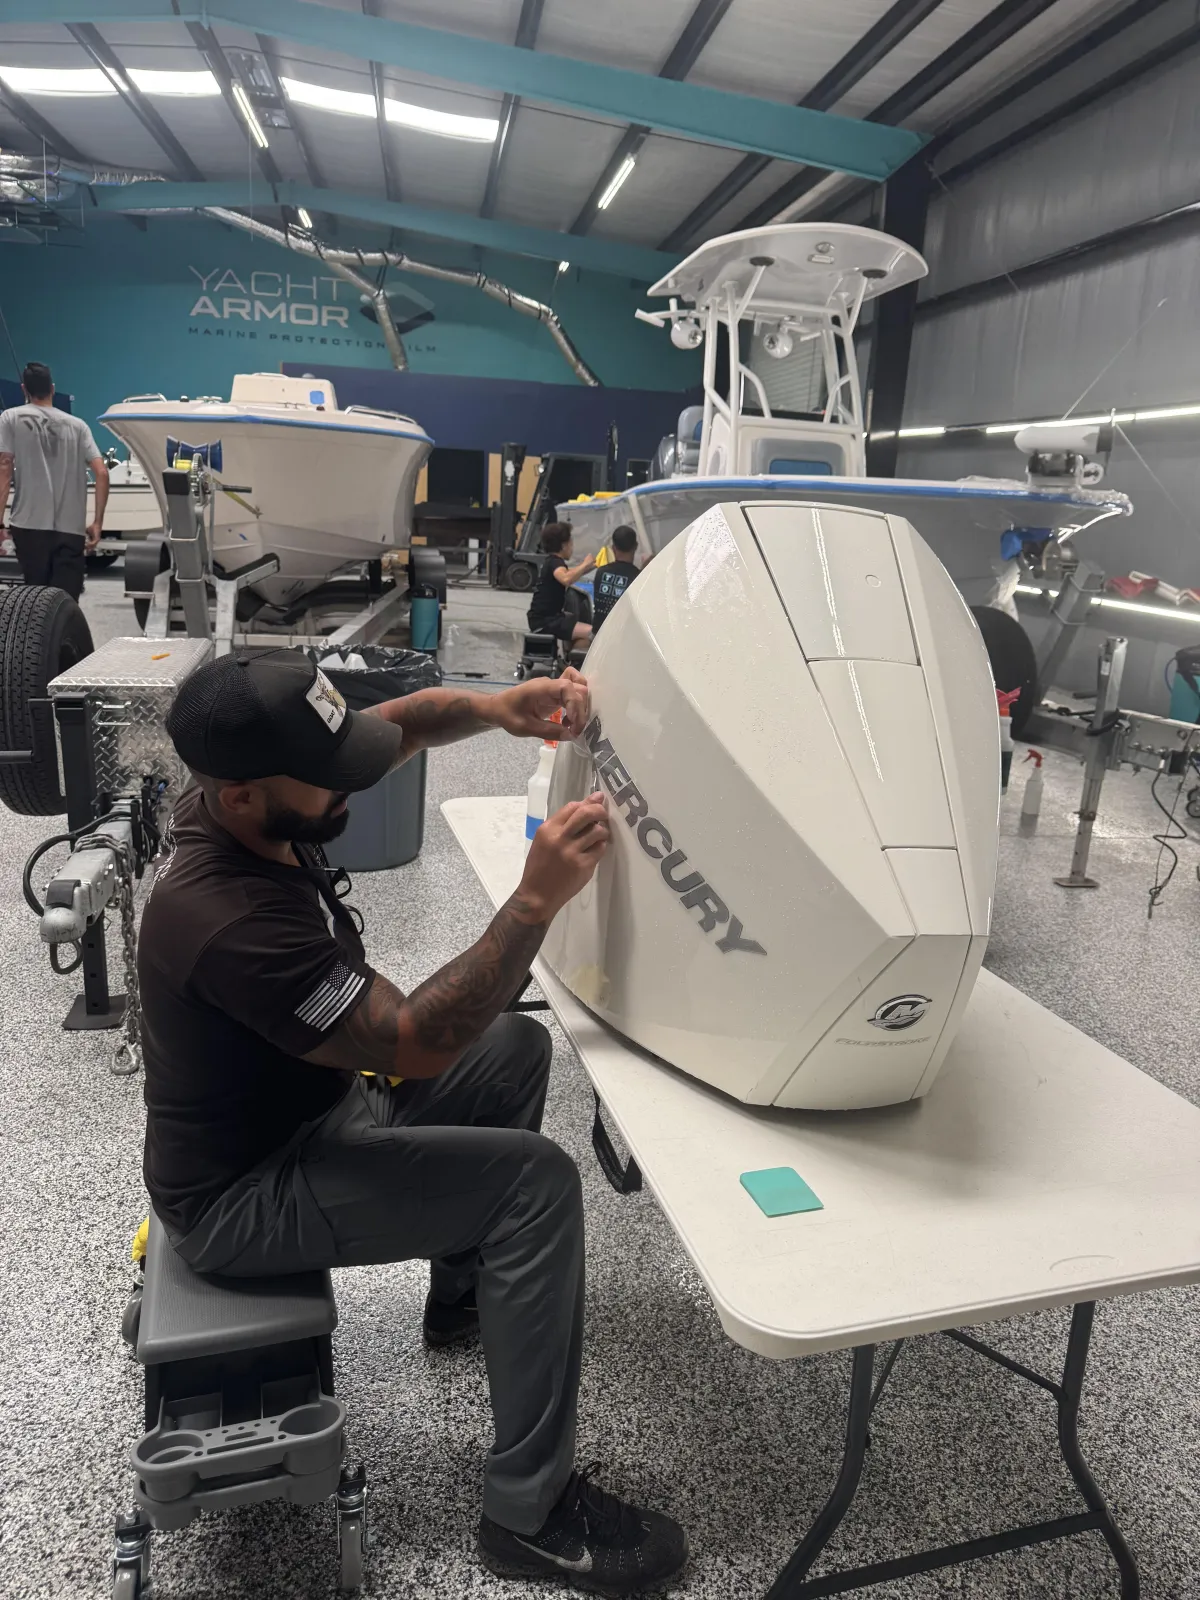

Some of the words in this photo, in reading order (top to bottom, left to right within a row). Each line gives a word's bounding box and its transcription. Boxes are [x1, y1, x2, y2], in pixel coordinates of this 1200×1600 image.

[189, 265, 349, 300] YACHT
[189, 296, 349, 328] ARMOR
[188, 327, 257, 339] MARINE
[269, 333, 386, 349] PROTECTION
[407, 344, 436, 352] ILM
[584, 716, 767, 956] MERCURY
